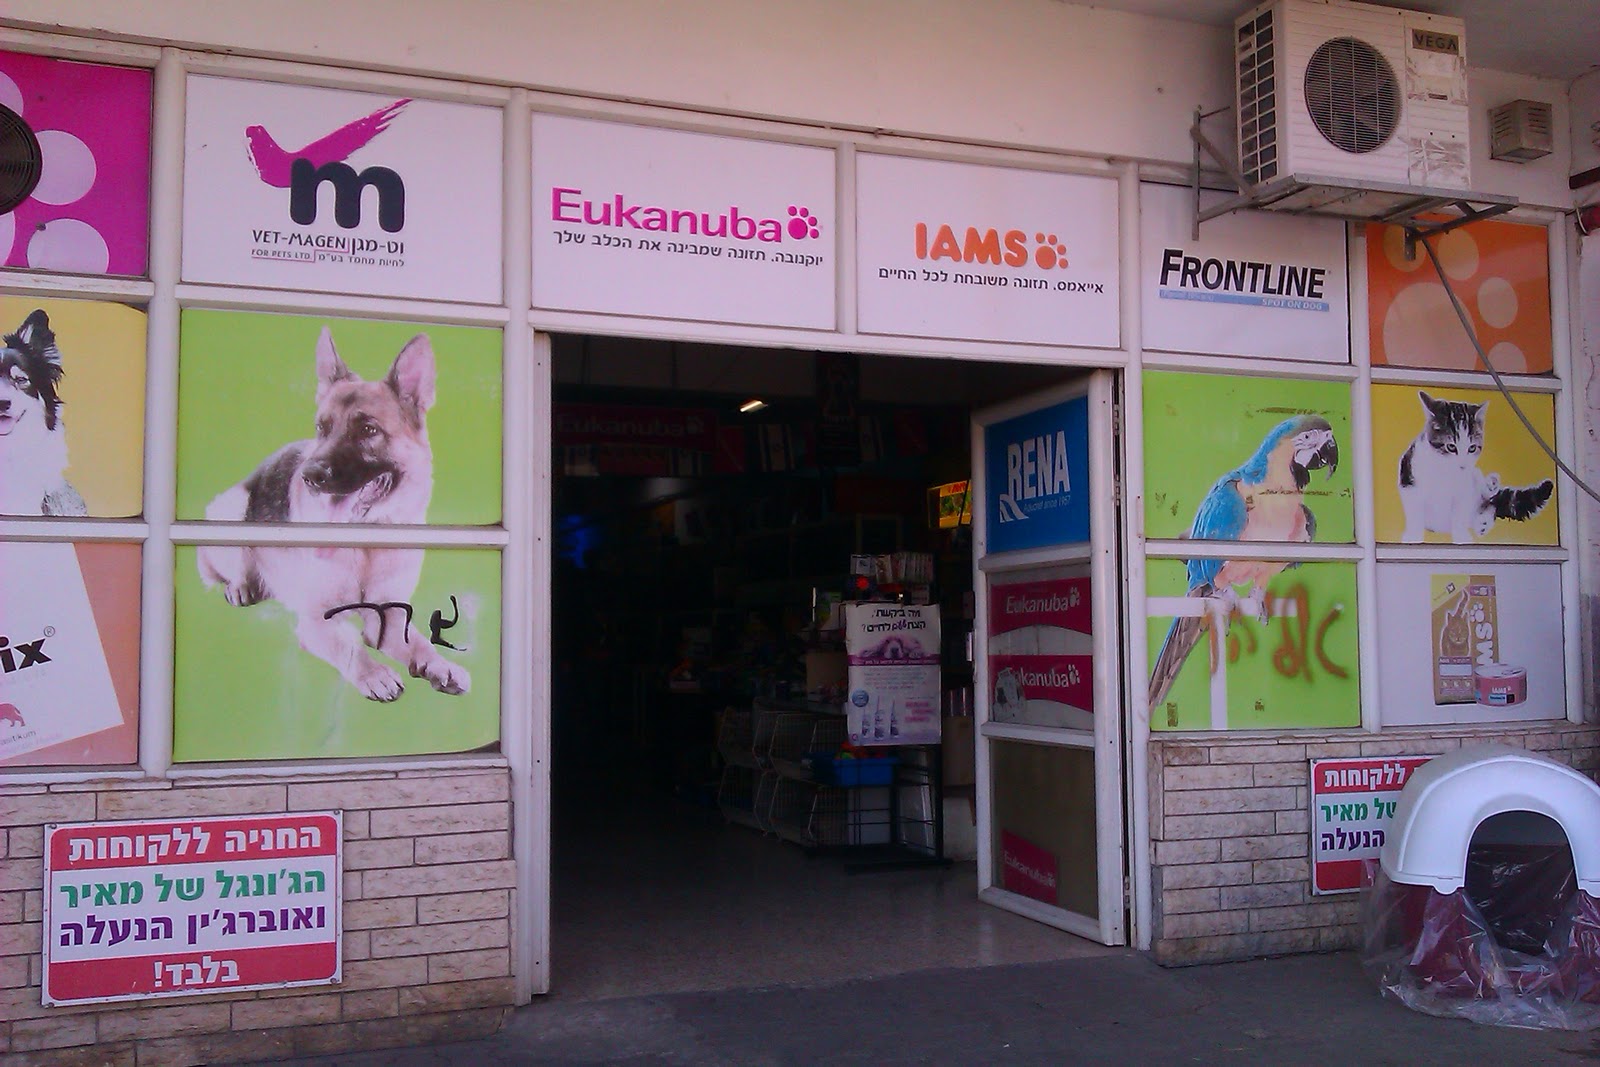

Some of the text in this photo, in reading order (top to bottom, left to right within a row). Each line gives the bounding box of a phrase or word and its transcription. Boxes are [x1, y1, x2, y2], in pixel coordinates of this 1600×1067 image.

[1414, 34, 1457, 49] VEGA
[552, 187, 782, 242] Eukanuba
[252, 229, 346, 249] VET-MAGEN
[351, 238, 404, 255] וט-מגן
[553, 229, 823, 267] יוקנובה. תזונה שמבינה את הכלב שלך
[914, 222, 1029, 267] IAMS
[251, 249, 269, 257] FOR
[349, 256, 375, 265] מחמד
[878, 267, 1104, 294] אייאמס. תזונה משובחת לכל החיים
[1159, 249, 1326, 299] FRONTLINE
[1262, 299, 1322, 310] SPOT ON DOG
[1007, 430, 1071, 500] RENA
[908, 609, 920, 618] מה
[1006, 593, 1069, 614] Eukanuba
[1324, 763, 1406, 791] ללקוחות
[1321, 797, 1397, 823] של מאיר
[68, 826, 321, 864] החניה ללקוחות
[1321, 828, 1385, 851] הנעלה
[60, 868, 325, 908] הג'ונגל של מאיר
[60, 914, 173, 947] הנעלה
[153, 955, 240, 988] בלבד!
